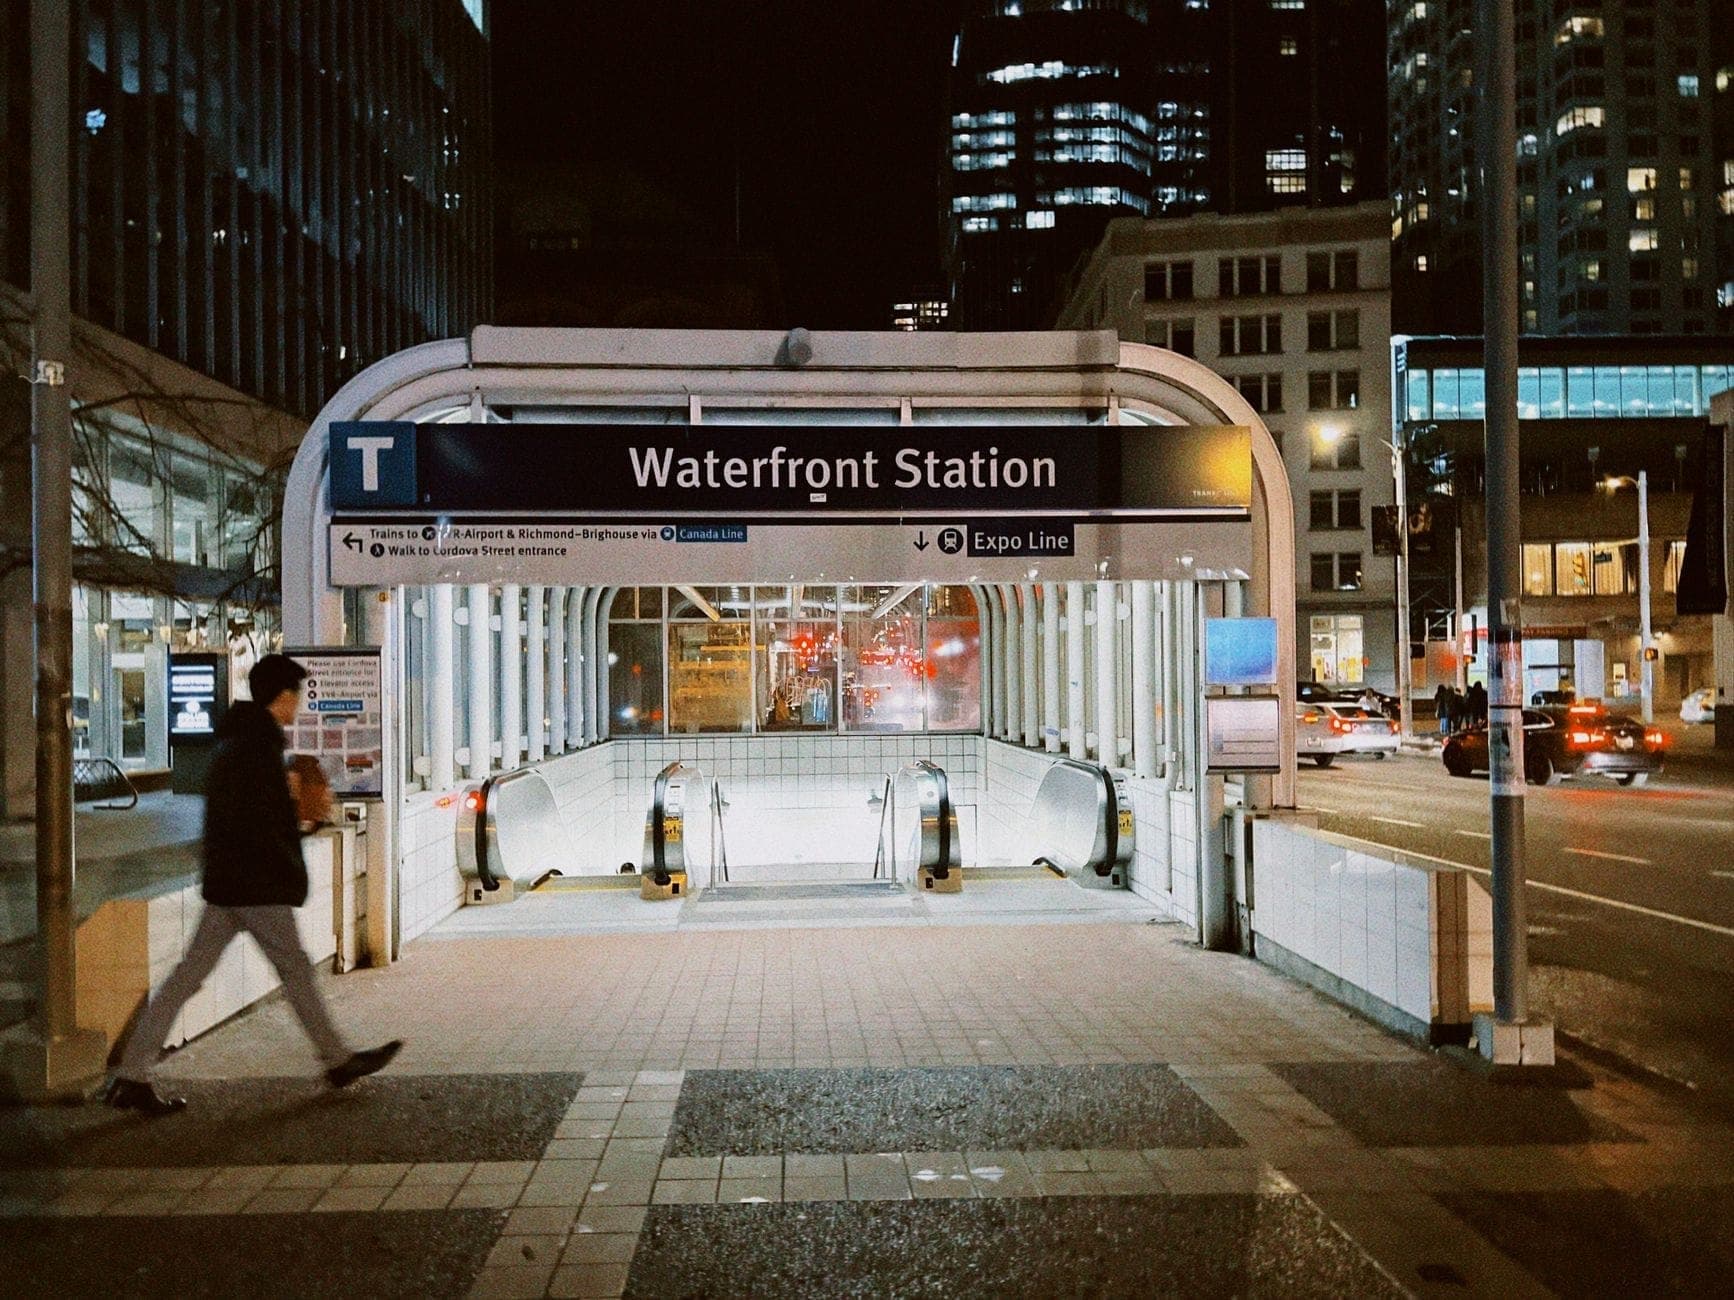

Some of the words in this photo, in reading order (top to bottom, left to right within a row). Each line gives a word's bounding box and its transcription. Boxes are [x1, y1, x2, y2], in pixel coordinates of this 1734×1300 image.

[346, 436, 394, 491] T
[628, 446, 880, 488] Waterfront
[894, 446, 1056, 488] Station
[370, 528, 404, 540] Trains
[407, 529, 418, 540] to
[438, 528, 504, 541] R-Airport
[506, 528, 516, 540] &
[641, 528, 657, 540] via
[679, 528, 719, 540] Canada
[722, 528, 744, 540] Line
[974, 531, 1022, 554] Expo
[1029, 531, 1069, 549] Line
[388, 545, 416, 556] Walk
[419, 546, 430, 556] to
[482, 545, 515, 556] Street
[518, 546, 567, 556] entrance
